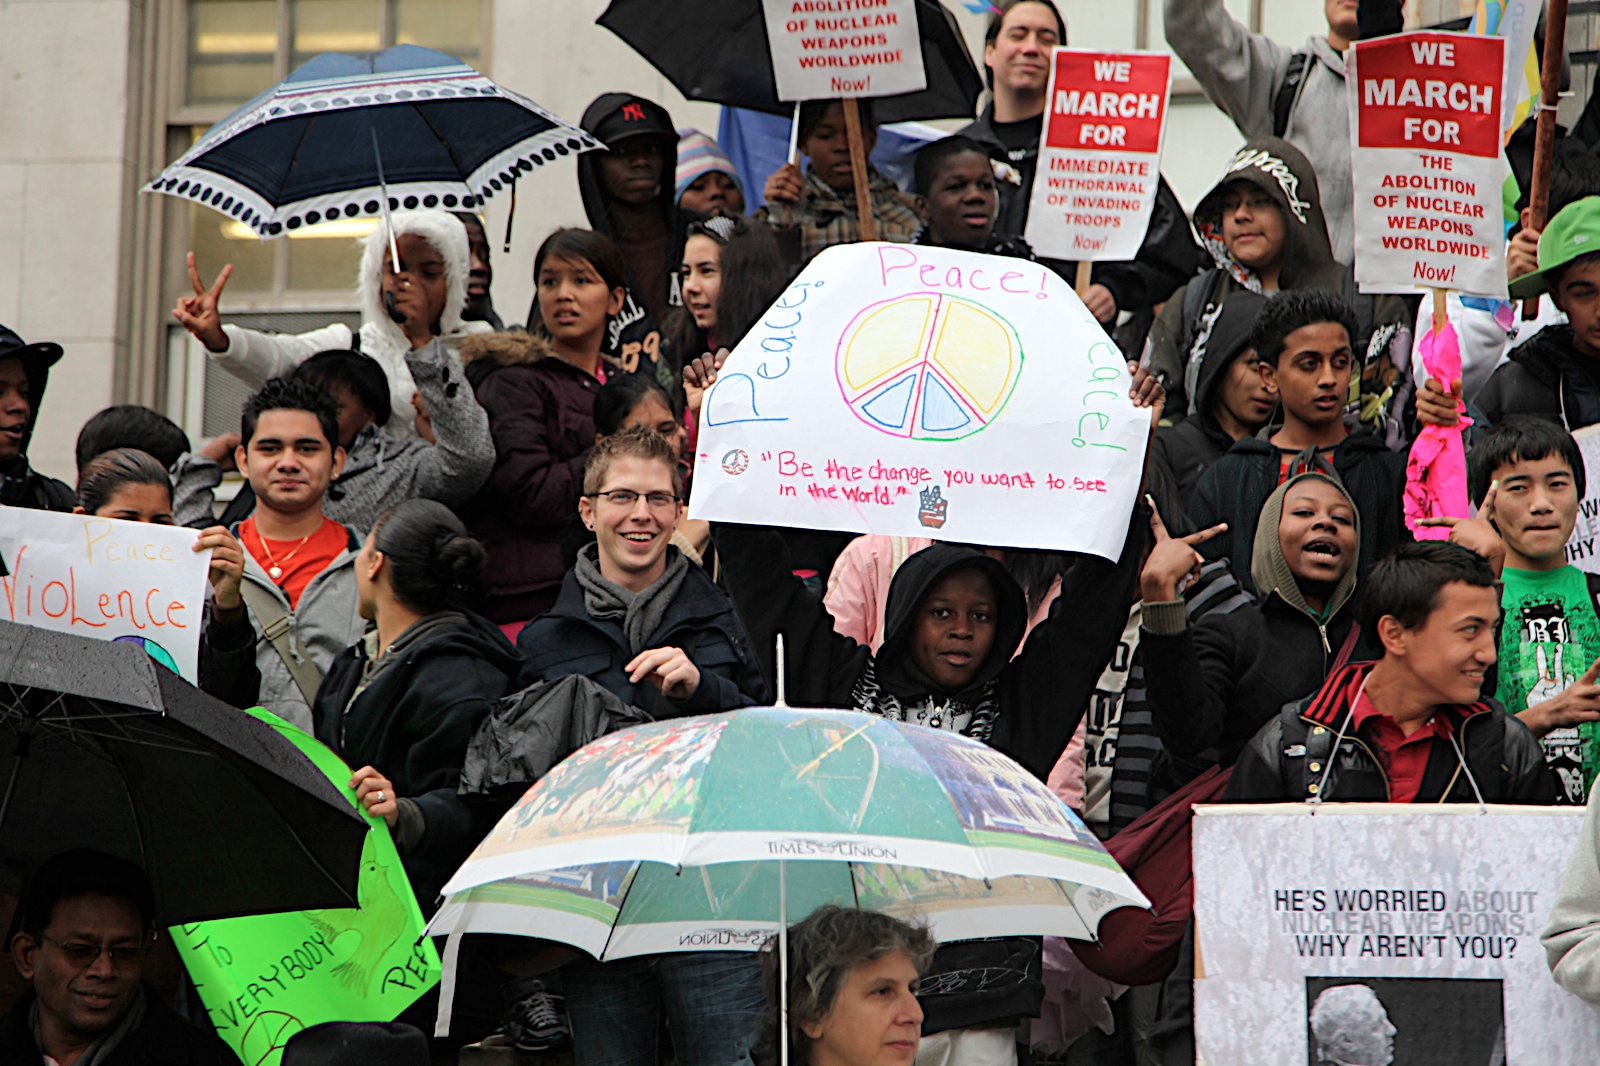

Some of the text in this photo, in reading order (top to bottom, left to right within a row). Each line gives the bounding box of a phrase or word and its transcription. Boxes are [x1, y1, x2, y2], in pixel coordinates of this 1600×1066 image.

[786, 13, 898, 33] OF NUCLEAR
[801, 33, 887, 50] WEAPONS
[798, 50, 903, 68] WORLDWIDE
[1411, 42, 1455, 66] WE
[1094, 60, 1131, 82] WE
[831, 75, 871, 92] Now!
[1054, 90, 1160, 119] MARCH
[1364, 78, 1493, 114] MARCH
[1079, 124, 1126, 146] FOR
[1404, 118, 1461, 145] FOR
[1050, 157, 1149, 176] IMMEDIATE
[1420, 155, 1453, 170] THE
[1047, 176, 1145, 194] WITHDRAWAL
[1381, 174, 1476, 196] ABOLITION
[1047, 194, 1141, 211] OF INVADING
[1373, 195, 1484, 218] OF NUCLEAR
[1065, 213, 1121, 228] TROOPS
[1387, 216, 1474, 236] WEAPONS
[1073, 234, 1108, 251] Now!
[1382, 236, 1490, 259] WORLDWIDE
[878, 246, 1048, 300] Peace!
[1413, 261, 1456, 282] Now!
[707, 280, 825, 426] Peace!
[1071, 320, 1128, 451] eace!
[824, 459, 863, 480] the
[869, 459, 932, 485] change
[944, 468, 974, 488] you
[981, 471, 1036, 489] want
[1046, 472, 1065, 490] to
[1074, 476, 1107, 492] see
[779, 484, 797, 497] in
[808, 483, 838, 499] the
[84, 519, 174, 564] Peace
[767, 841, 897, 860] TIMES UNION
[1275, 890, 1538, 913] HE'S WORRIED ABOUT
[1282, 912, 1533, 936] NUCLEAR WEAPONS.
[1296, 935, 1517, 959] WHY AREN'T YOU?
